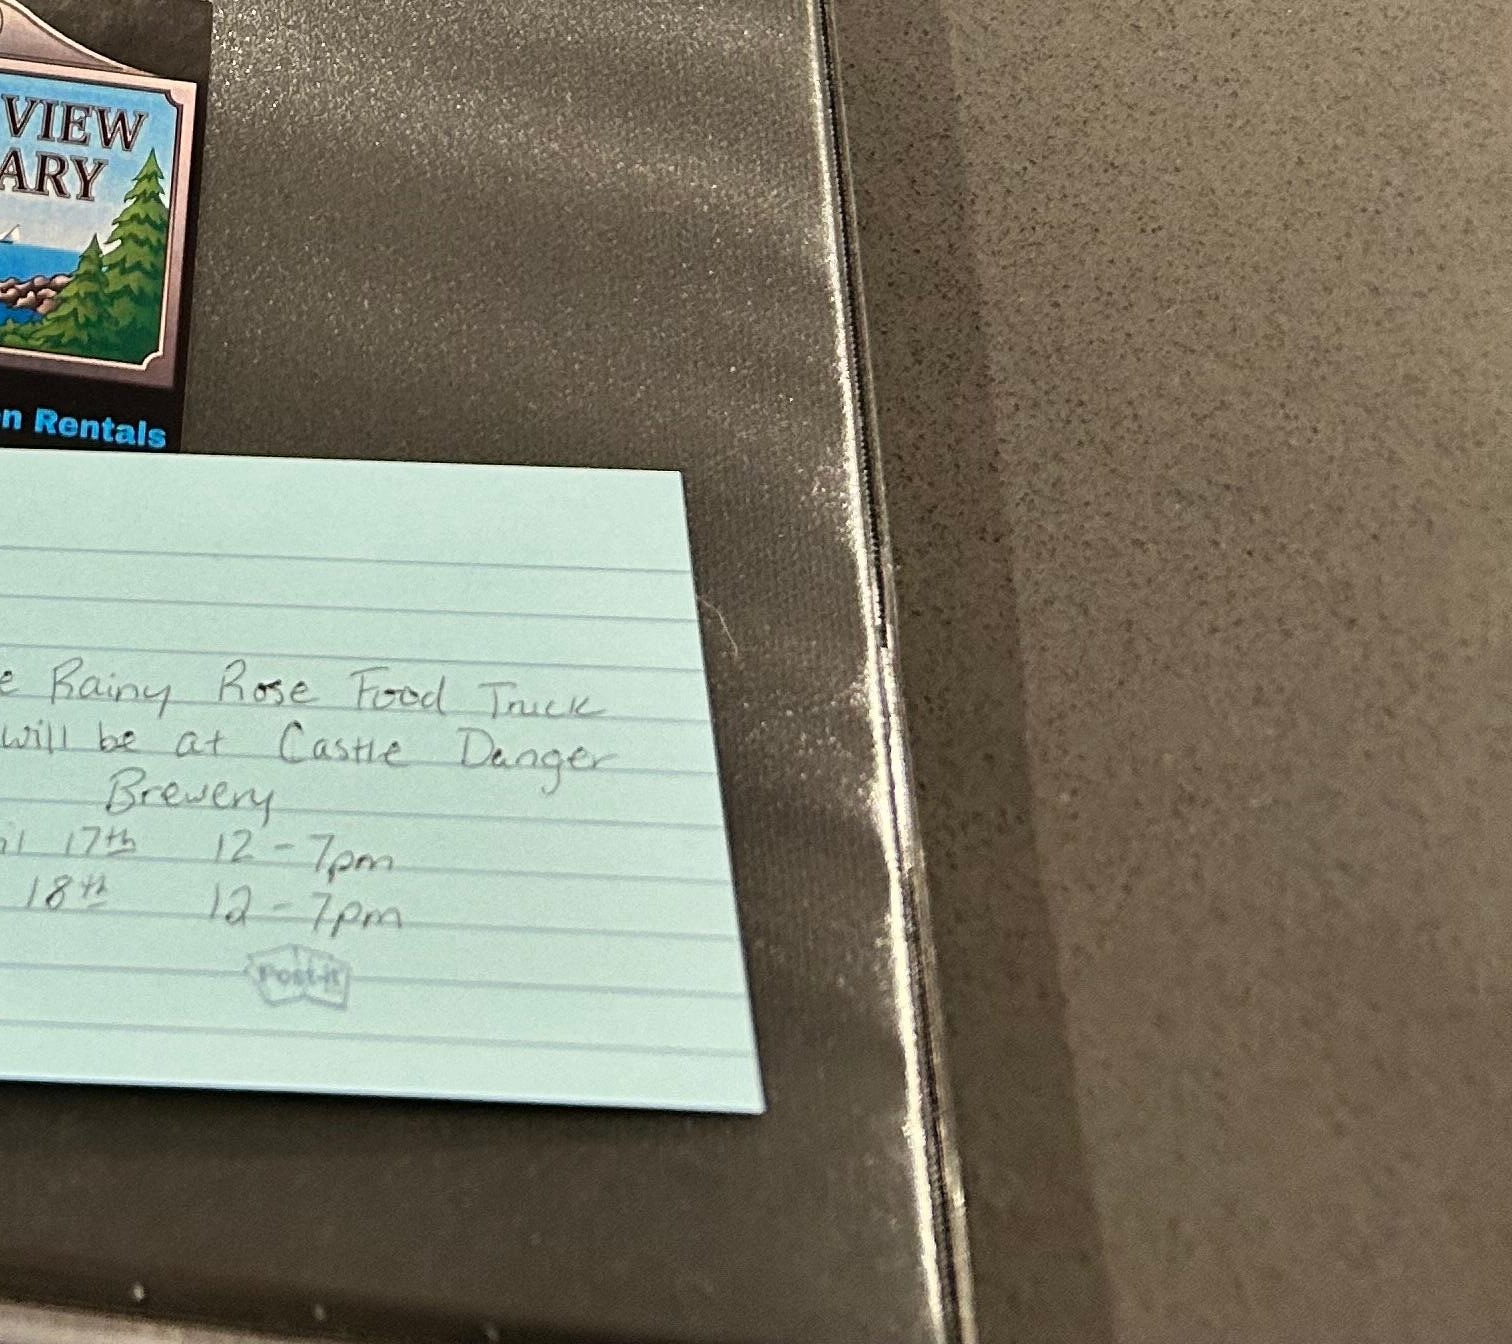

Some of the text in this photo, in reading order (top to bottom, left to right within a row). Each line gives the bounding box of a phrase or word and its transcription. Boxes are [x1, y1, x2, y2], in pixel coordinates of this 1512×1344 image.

[1, 92, 150, 153] VIEW
[34, 408, 168, 450] Rentals
[51, 656, 173, 720] Rainy
[219, 659, 319, 705] Rose
[351, 665, 448, 716] Food
[478, 681, 606, 720] Truck
[1, 719, 618, 796] will be at Castle Danger
[105, 766, 275, 828] Brewery
